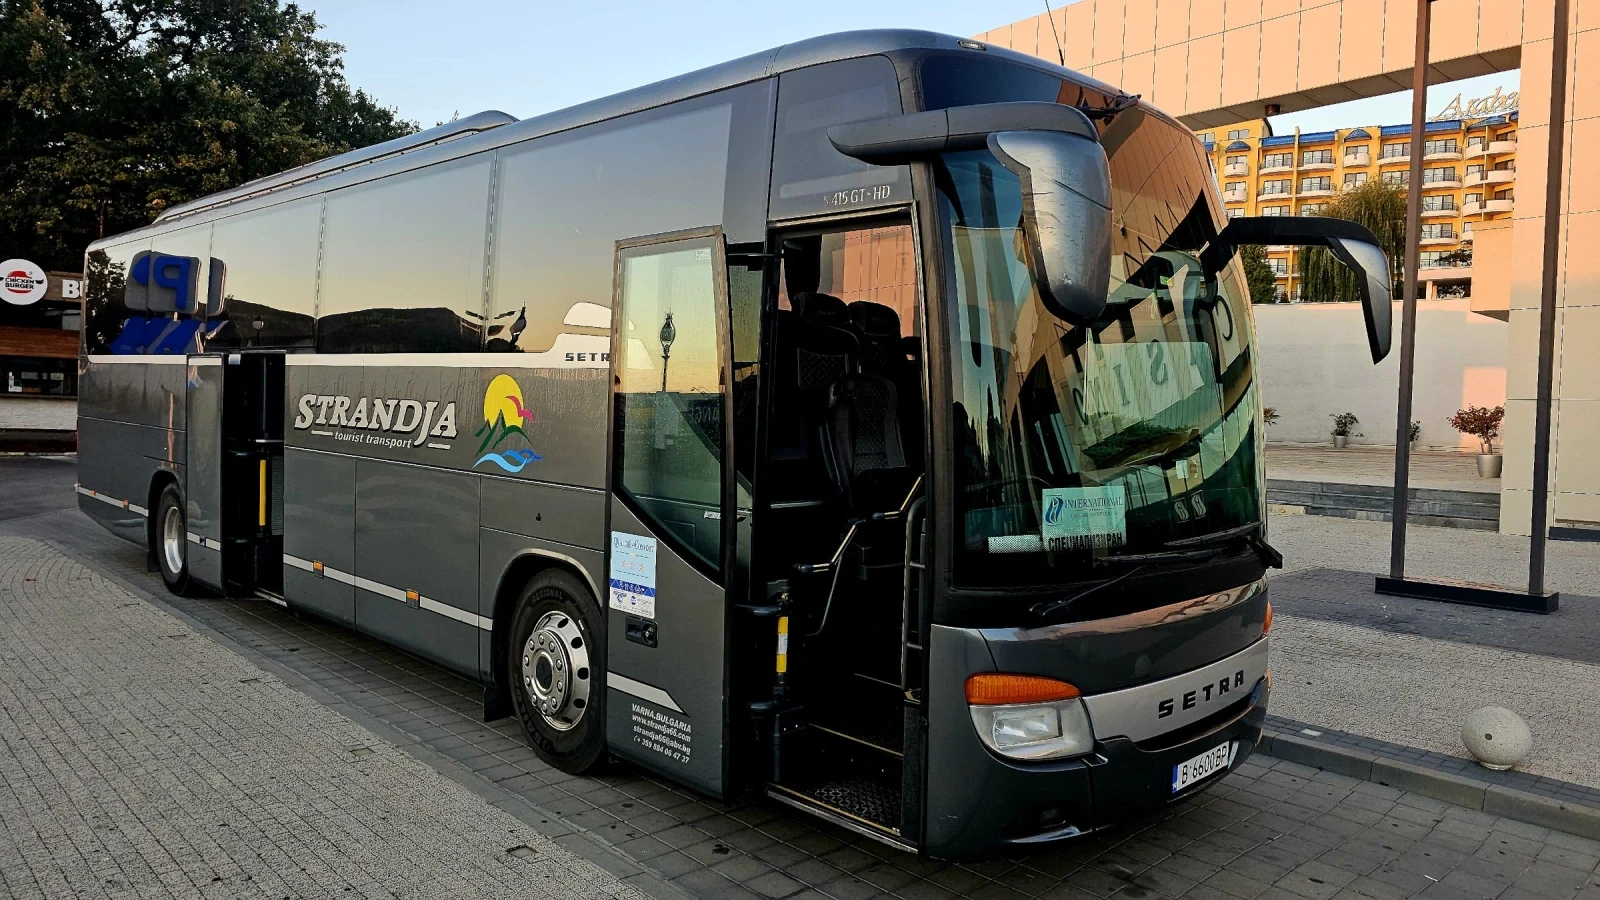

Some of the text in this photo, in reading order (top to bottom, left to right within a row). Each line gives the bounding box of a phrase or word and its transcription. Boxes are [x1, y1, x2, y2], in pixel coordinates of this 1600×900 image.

[831, 191, 848, 206] 415
[5, 275, 34, 284] CHICKEN
[565, 352, 610, 362] SETR
[294, 393, 458, 447] STRANDJA
[334, 430, 412, 449] tourist transport
[1064, 496, 1123, 509] INTERNATIONAL
[531, 588, 563, 604] REGIONAL
[1158, 669, 1244, 719] SETRA
[632, 714, 691, 742] www.strandja66.com
[642, 738, 653, 748] 359
[672, 752, 681, 760] 47
[681, 755, 690, 764] 37
